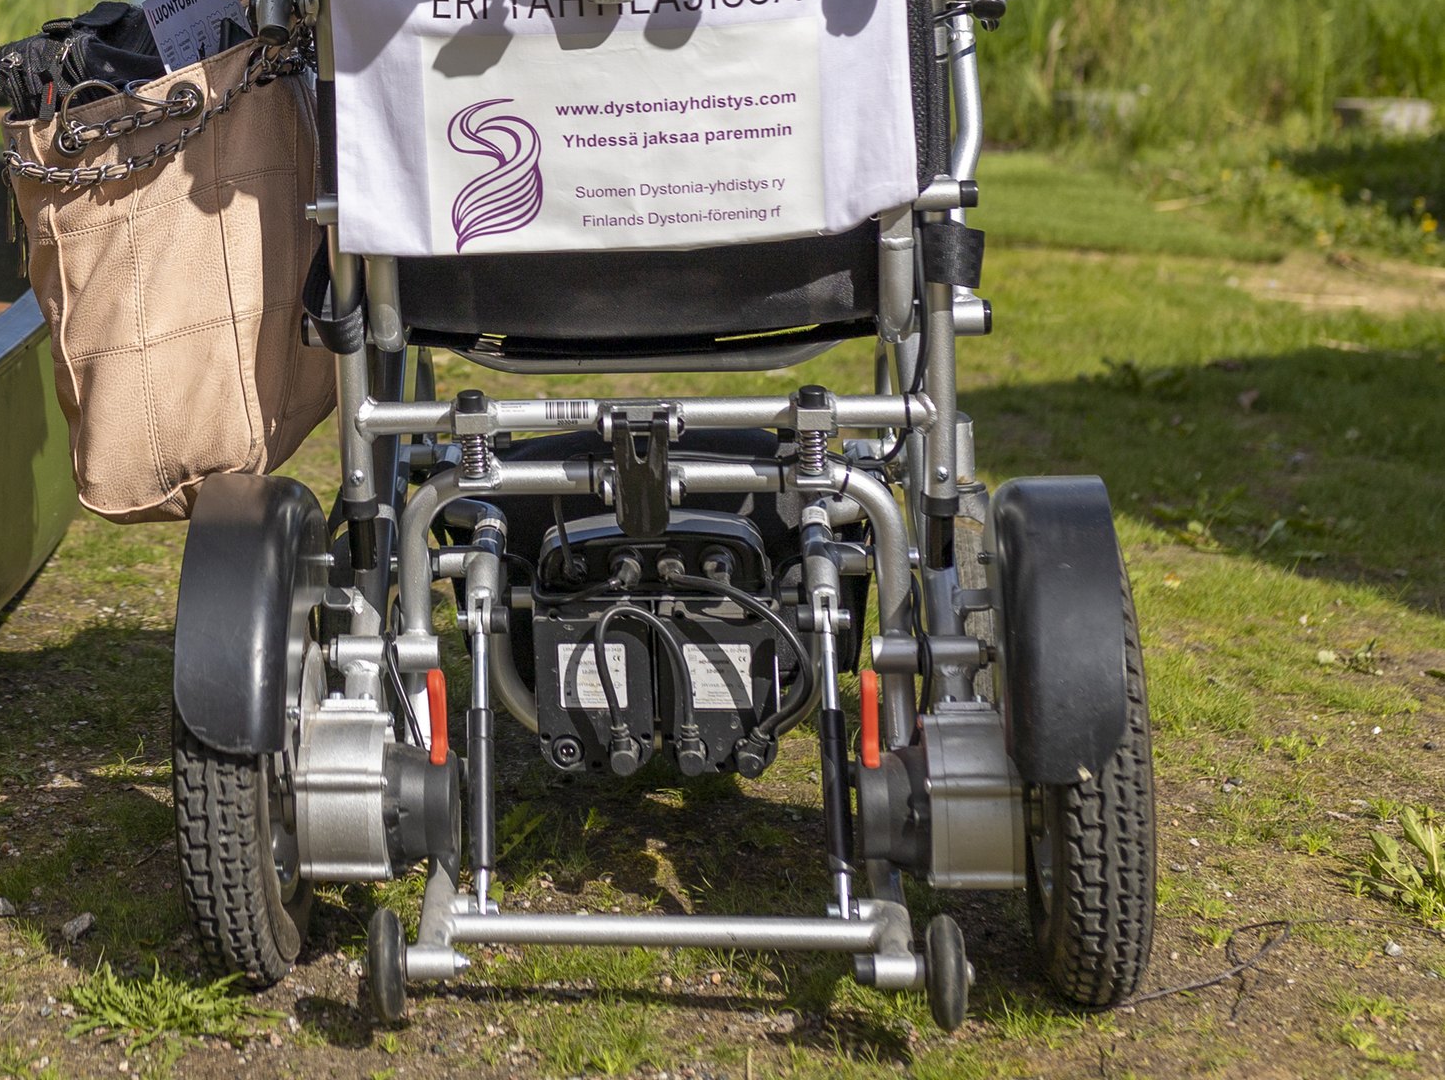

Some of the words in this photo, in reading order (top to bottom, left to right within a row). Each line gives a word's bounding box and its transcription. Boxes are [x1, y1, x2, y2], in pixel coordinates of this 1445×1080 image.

[554, 91, 797, 118] www.dystoniayhdistys.com
[562, 131, 639, 149] Yhdessä
[641, 129, 700, 149] jaksaa
[704, 123, 793, 145] paremmin
[575, 185, 637, 199] Suomen
[639, 177, 770, 199] Dystonia-yhdistys
[771, 177, 786, 190] ry
[582, 214, 645, 228] Finlands
[647, 207, 768, 228] Dystoni-förening
[769, 205, 782, 218] rf
